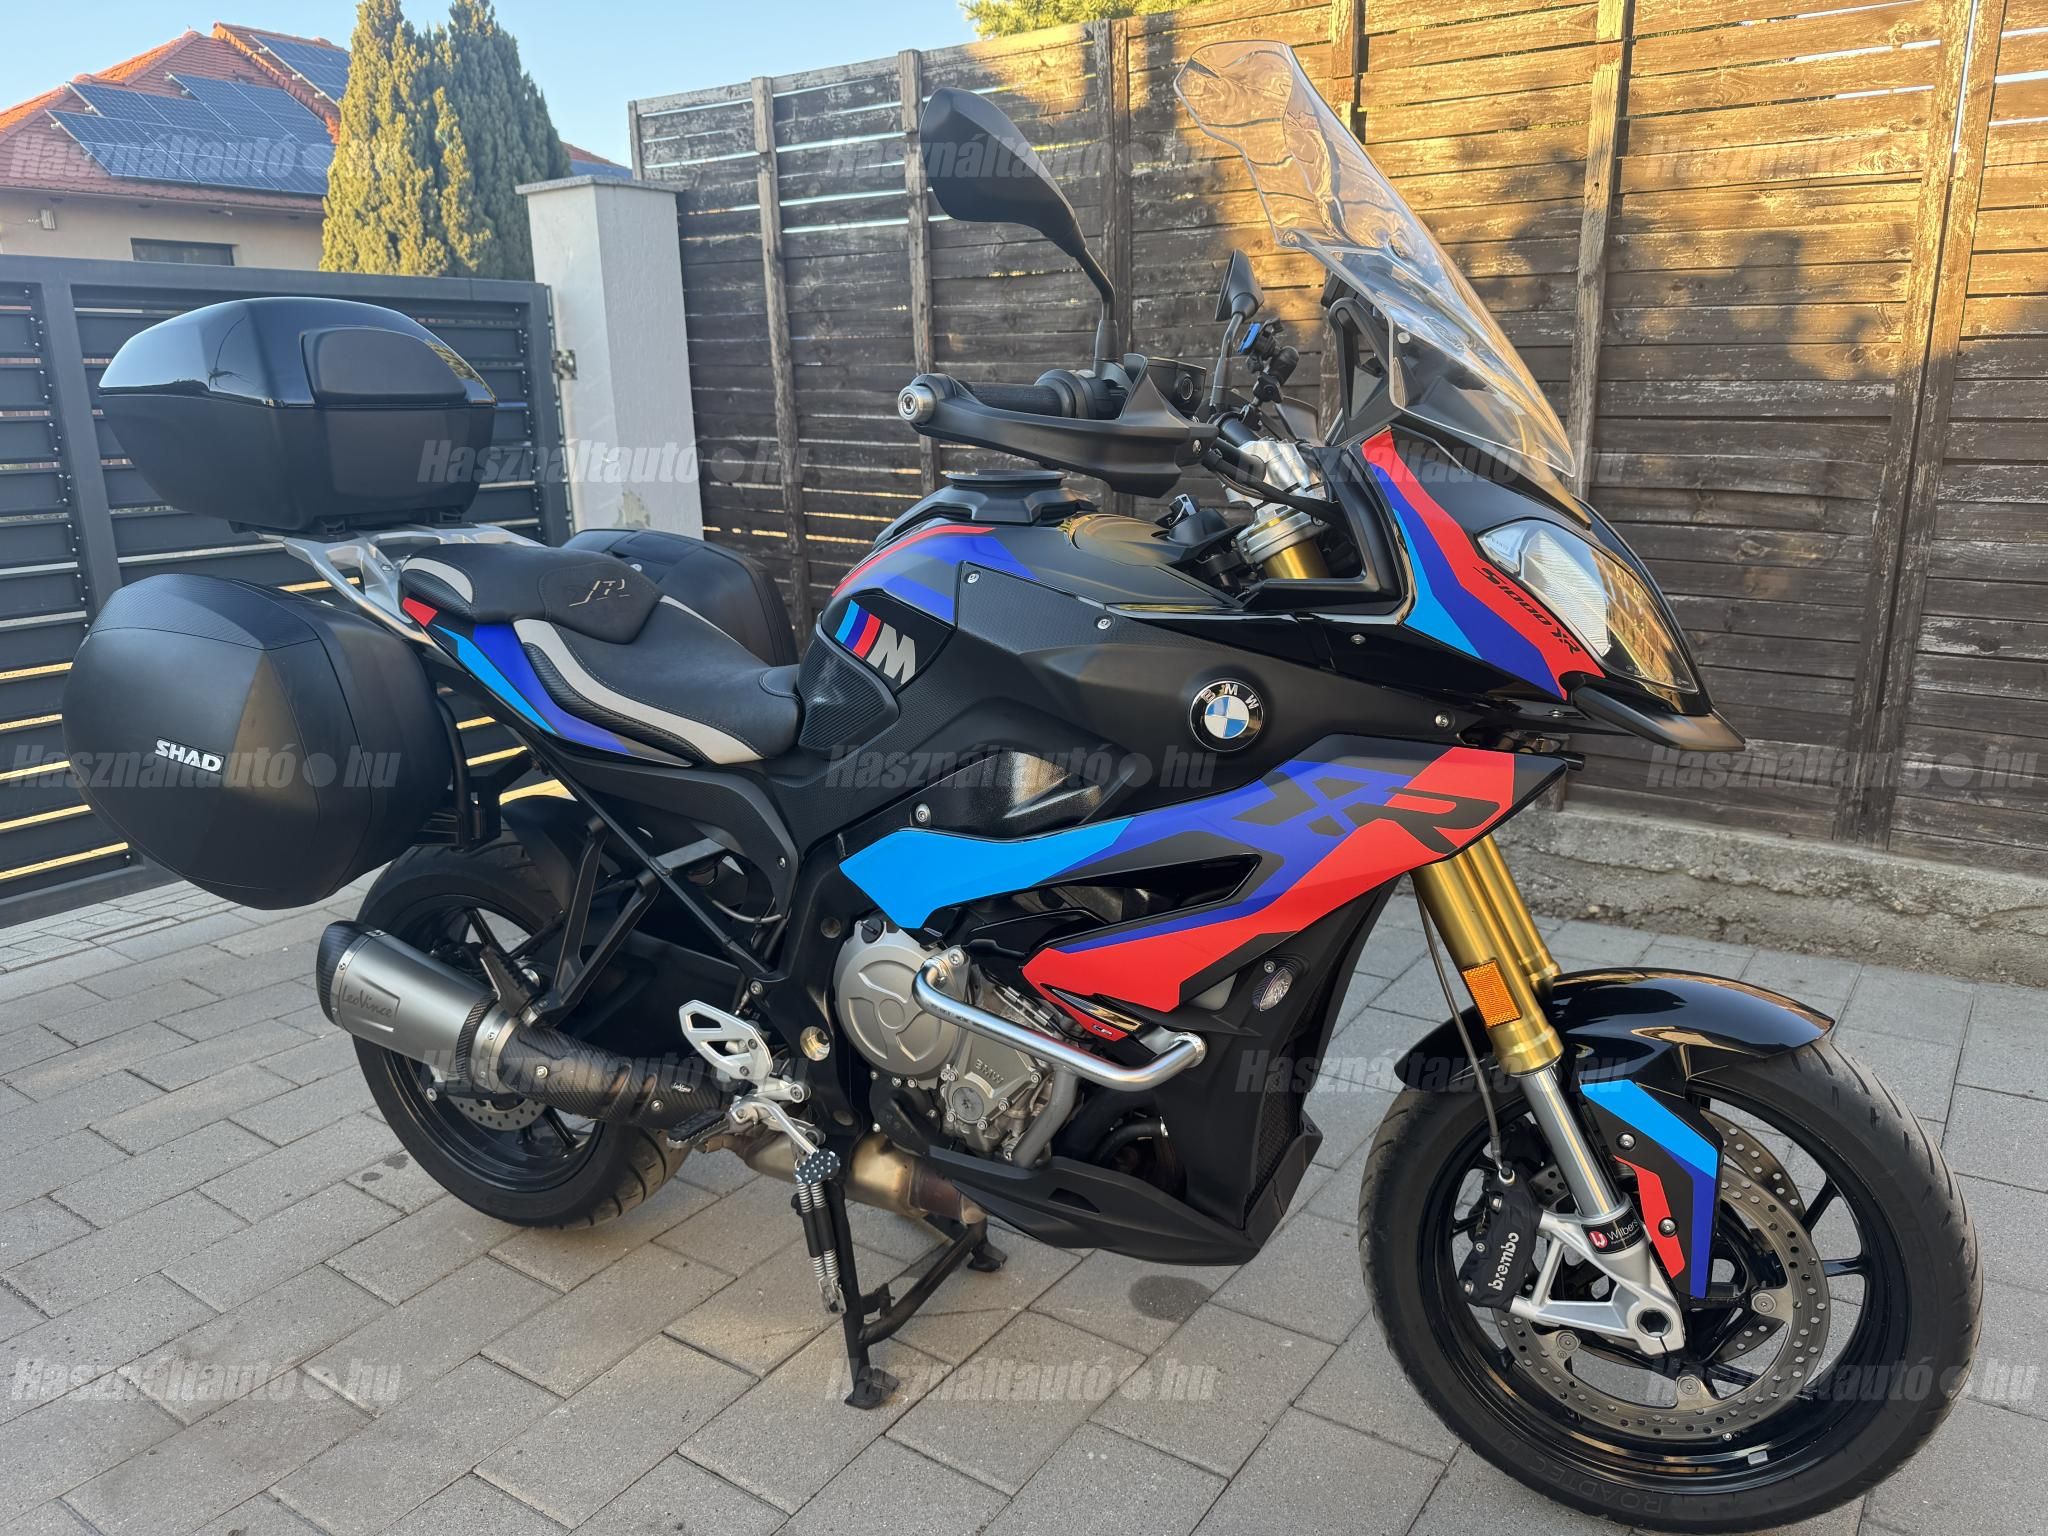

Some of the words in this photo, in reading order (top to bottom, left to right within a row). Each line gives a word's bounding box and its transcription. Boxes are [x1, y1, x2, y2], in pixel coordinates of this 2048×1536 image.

[866, 622, 917, 687] M
[1200, 682, 1260, 710] BMW
[154, 739, 222, 772] SHAD
[1606, 1219, 1638, 1241] Wilbers
[1487, 1232, 1520, 1291] brembo
